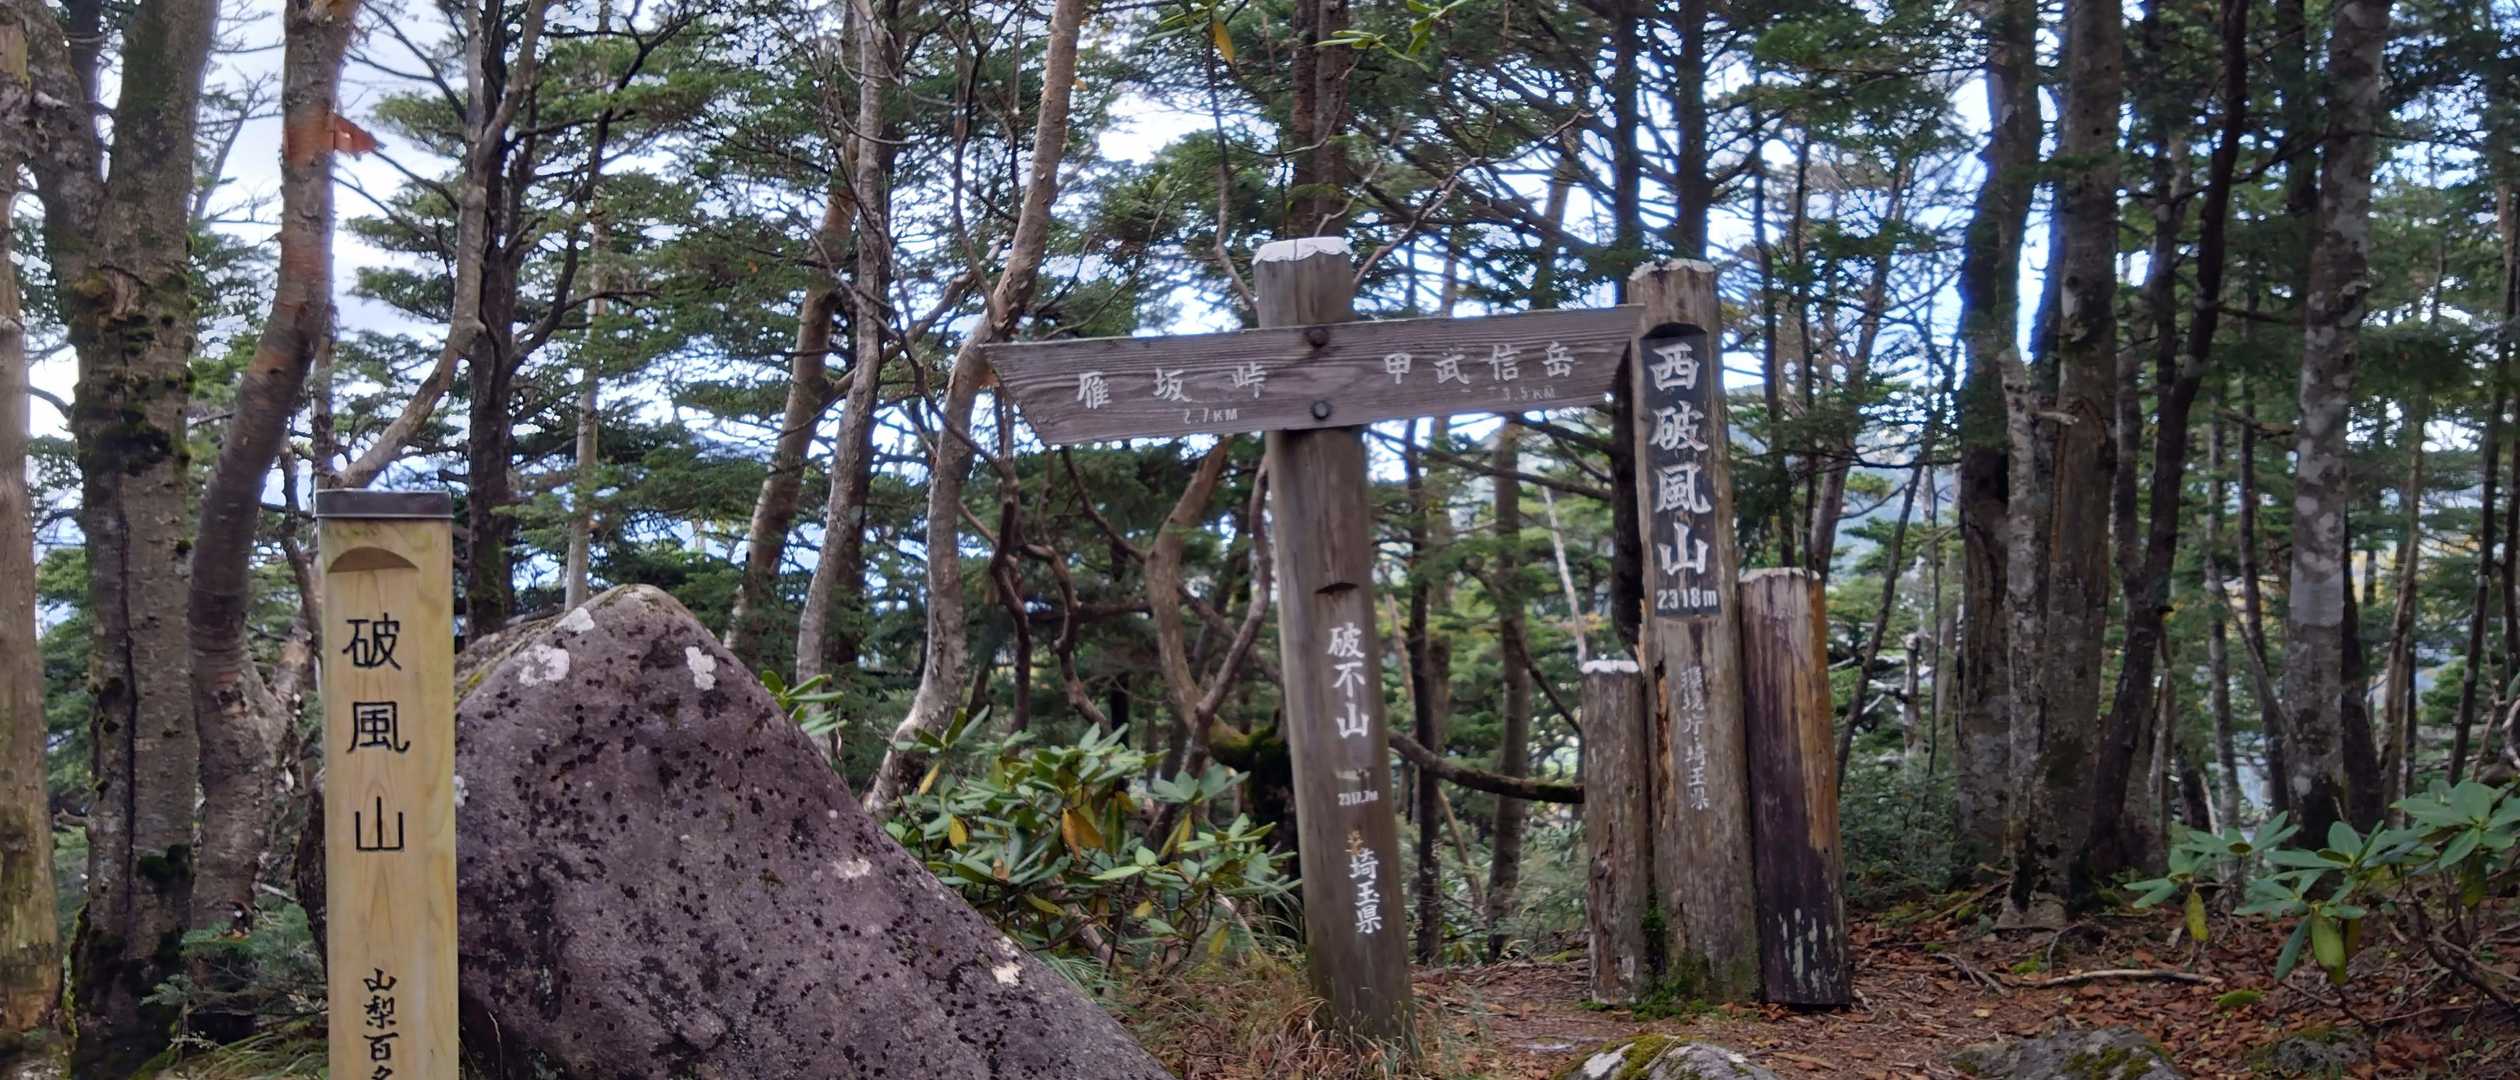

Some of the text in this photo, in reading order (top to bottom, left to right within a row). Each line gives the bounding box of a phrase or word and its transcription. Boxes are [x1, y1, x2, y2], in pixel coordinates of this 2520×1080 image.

[1077, 361, 1267, 409] 雁坂峠
[1384, 341, 1575, 385] 甲武信岳
[1650, 342, 1712, 577] 西破風山
[1656, 587, 1718, 609] 2318m
[1327, 622, 1370, 739] 破不山
[342, 612, 411, 853] 破風山
[1349, 848, 1383, 934] 埼玉県
